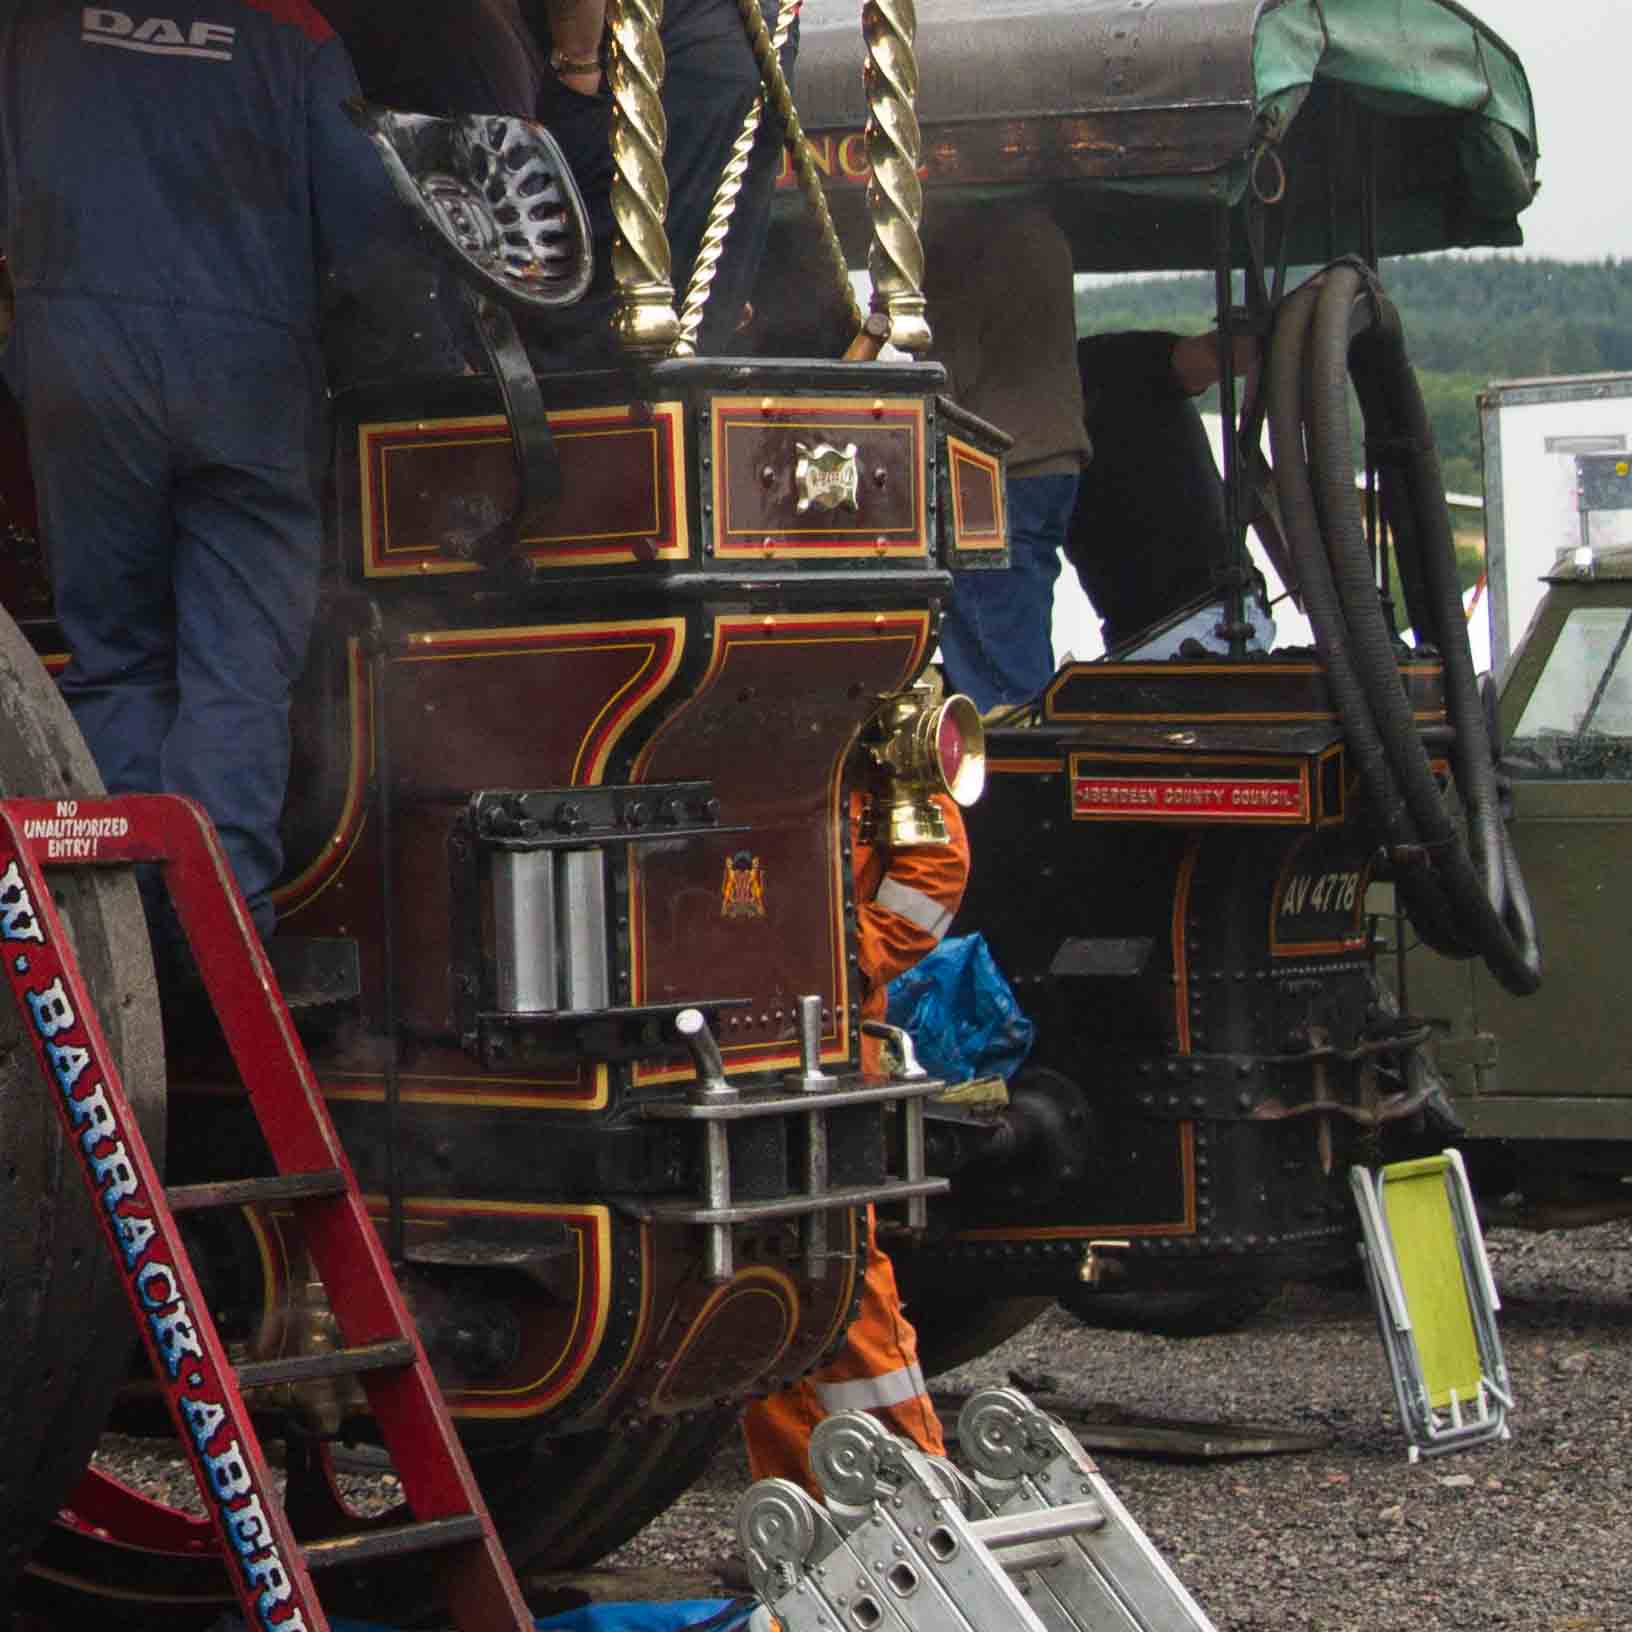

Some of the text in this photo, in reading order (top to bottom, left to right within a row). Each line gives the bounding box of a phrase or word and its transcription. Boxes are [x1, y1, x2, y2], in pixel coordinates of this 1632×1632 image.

[81, 7, 236, 46] DAF
[56, 800, 79, 817] NO
[1164, 787, 1225, 805] COUNTY
[1231, 788, 1294, 806] COUNCIL
[24, 817, 129, 839] UNAUTHORIZED
[1281, 871, 1360, 916] AV 4778
[26, 975, 203, 1385] BARRACK
